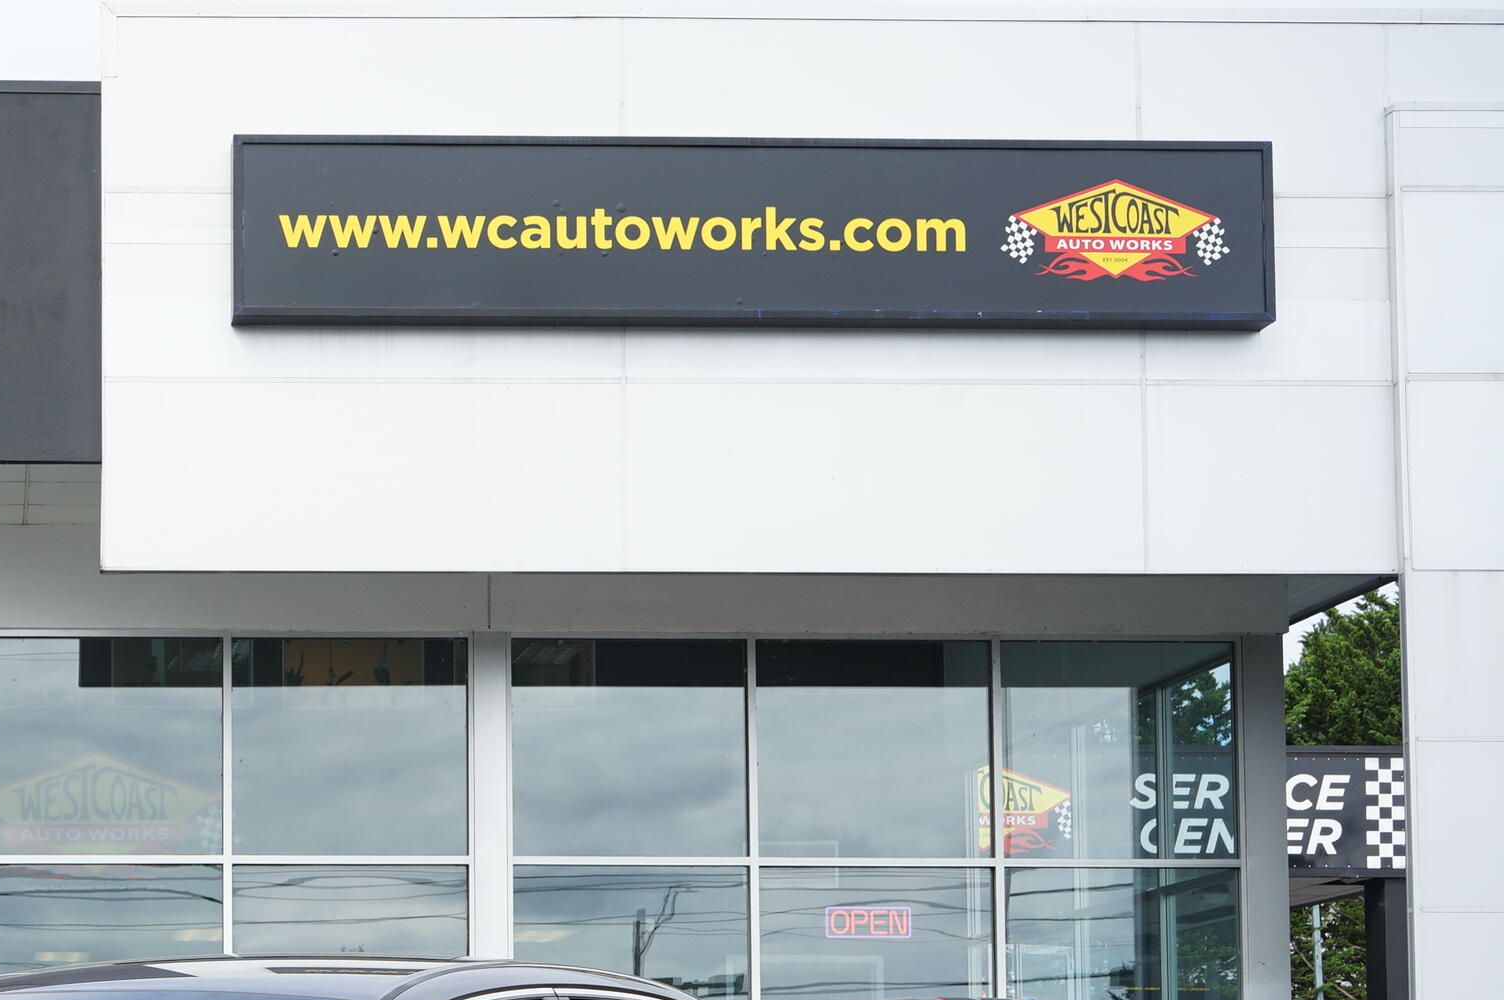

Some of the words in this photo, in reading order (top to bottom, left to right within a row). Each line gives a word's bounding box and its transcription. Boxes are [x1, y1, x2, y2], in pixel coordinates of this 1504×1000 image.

[279, 206, 966, 253] www.wcautoworks.com
[1056, 239, 1105, 250] AUTO
[1109, 239, 1173, 251] WORKS
[1129, 773, 1351, 811] SERCE
[20, 827, 81, 841] AUTO
[88, 827, 170, 841] WORKS
[830, 910, 908, 935] OPEN
